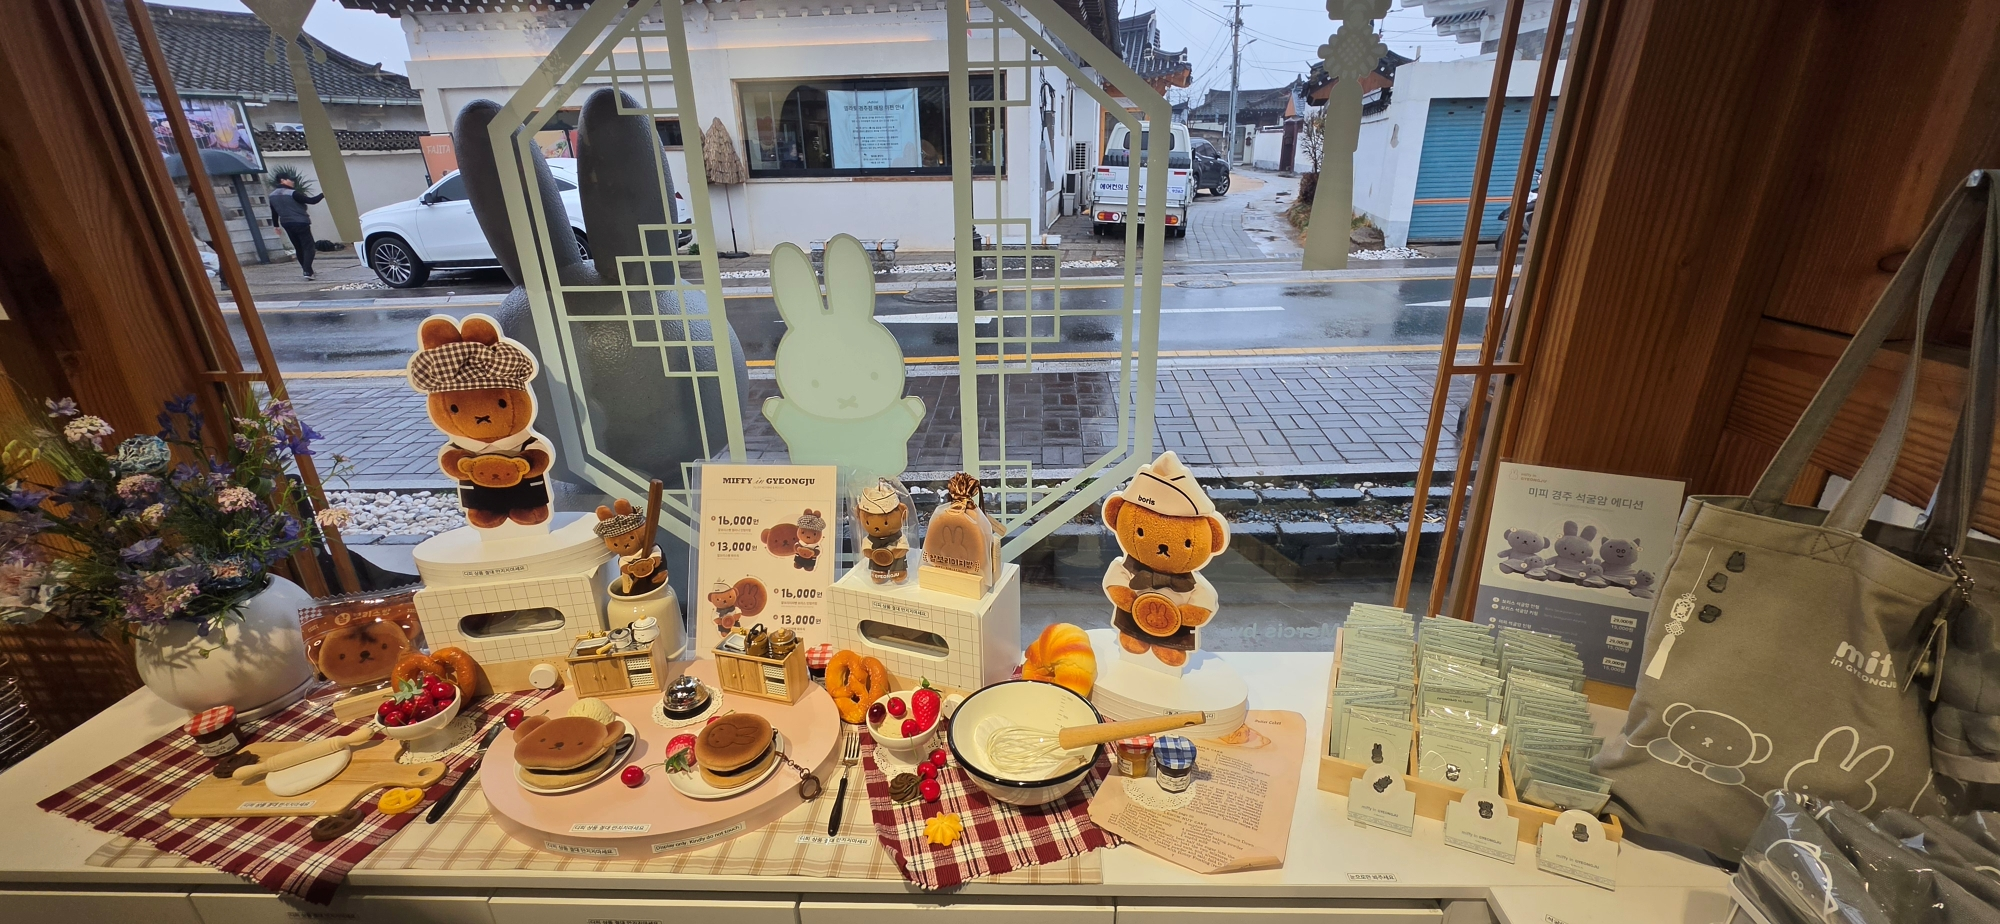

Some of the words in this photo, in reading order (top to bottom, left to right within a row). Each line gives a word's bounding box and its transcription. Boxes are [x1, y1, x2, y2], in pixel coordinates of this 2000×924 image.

[766, 478, 815, 486] GYEONGJU
[1138, 495, 1156, 505] boris
[1528, 487, 1549, 498] 미피
[1552, 490, 1573, 501] 경주
[1575, 493, 1608, 506] 석굴암
[1611, 497, 1644, 510] 에디션
[718, 516, 759, 526] 16,000원
[717, 542, 757, 552] 13,000원
[782, 588, 823, 599] 16,000원
[781, 615, 821, 625] 13,000원
[1830, 656, 1843, 667] in
